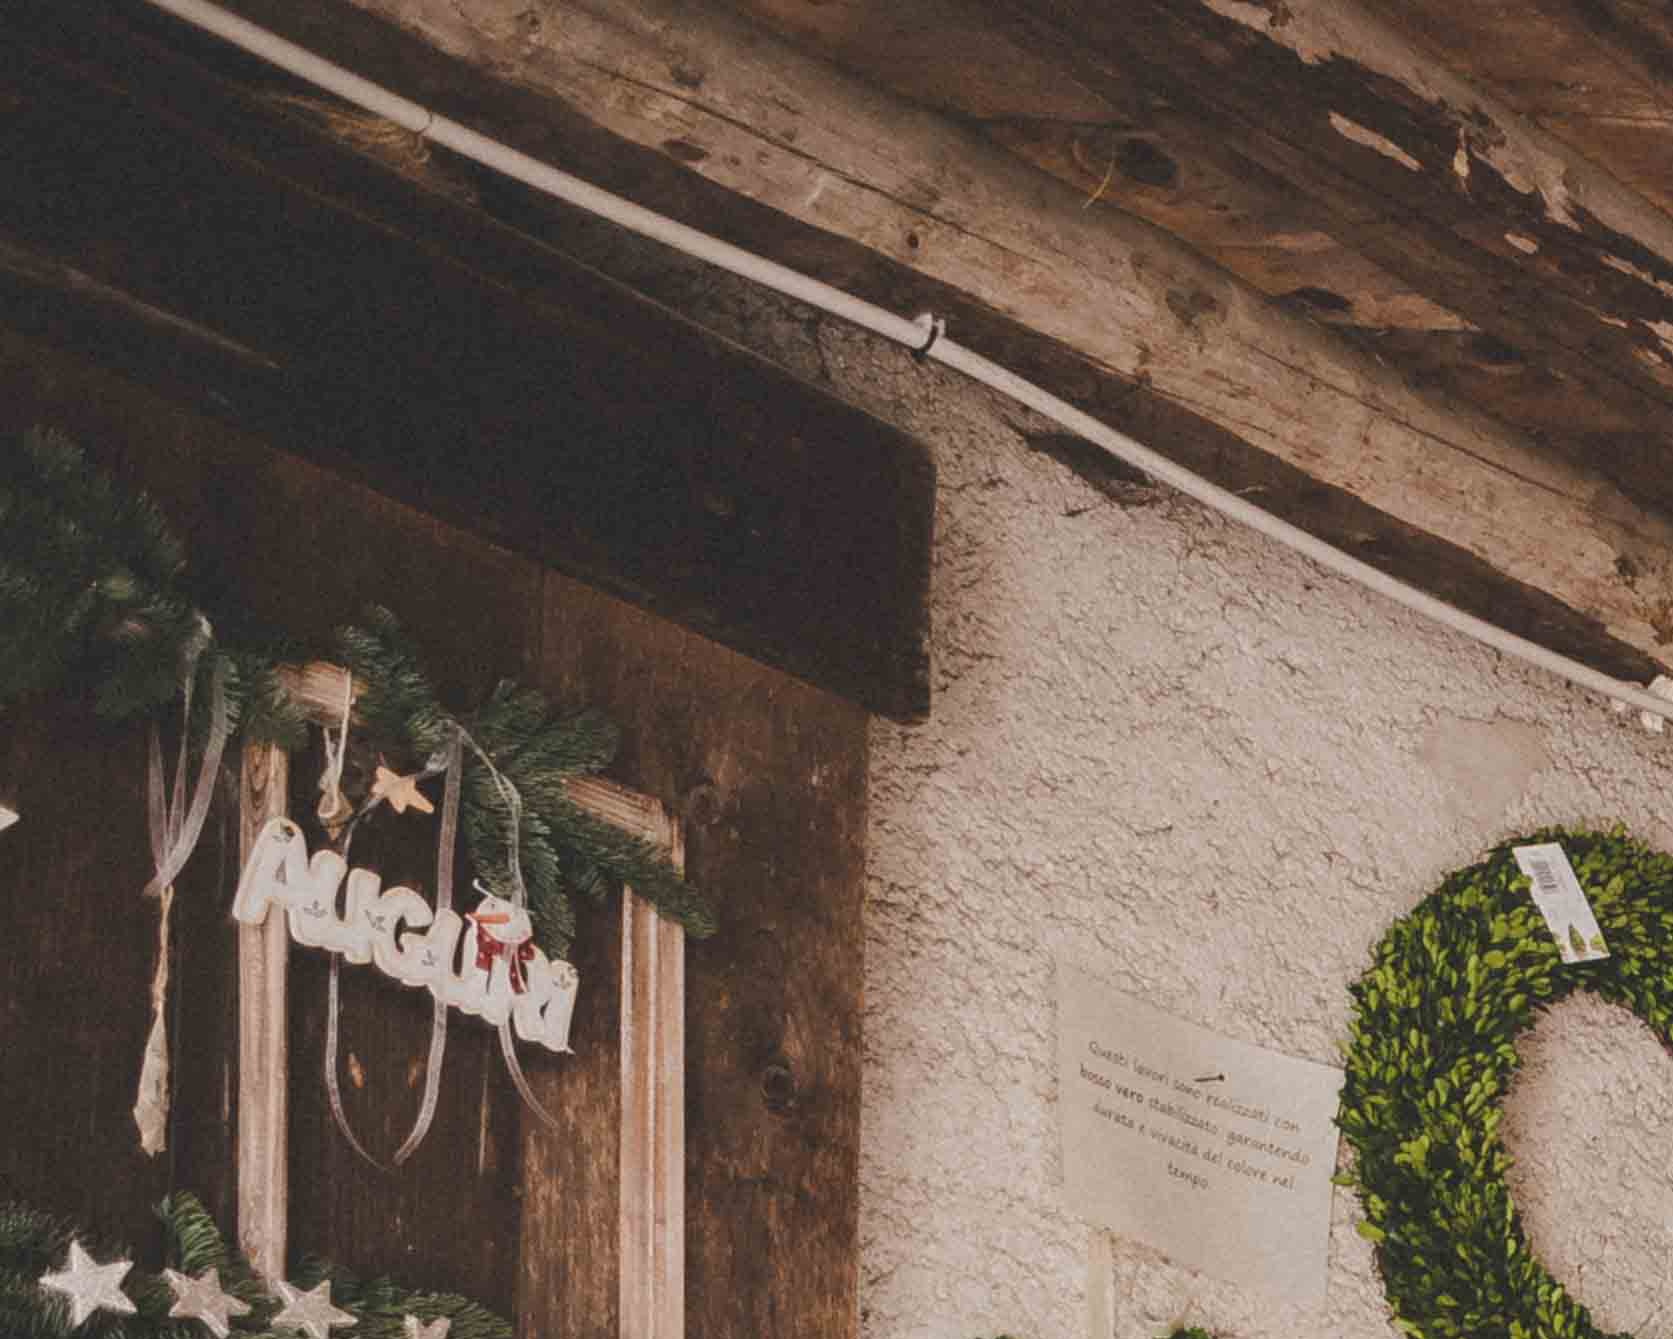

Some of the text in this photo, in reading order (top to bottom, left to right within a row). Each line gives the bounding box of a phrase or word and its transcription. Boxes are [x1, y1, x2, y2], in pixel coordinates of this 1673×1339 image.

[1089, 1040, 1127, 1065] Questi
[1134, 1058, 1168, 1086] lavori
[1115, 1084, 1144, 1103] vero
[1168, 1160, 1208, 1189] tempo
[1227, 1159, 1267, 1180] colore
